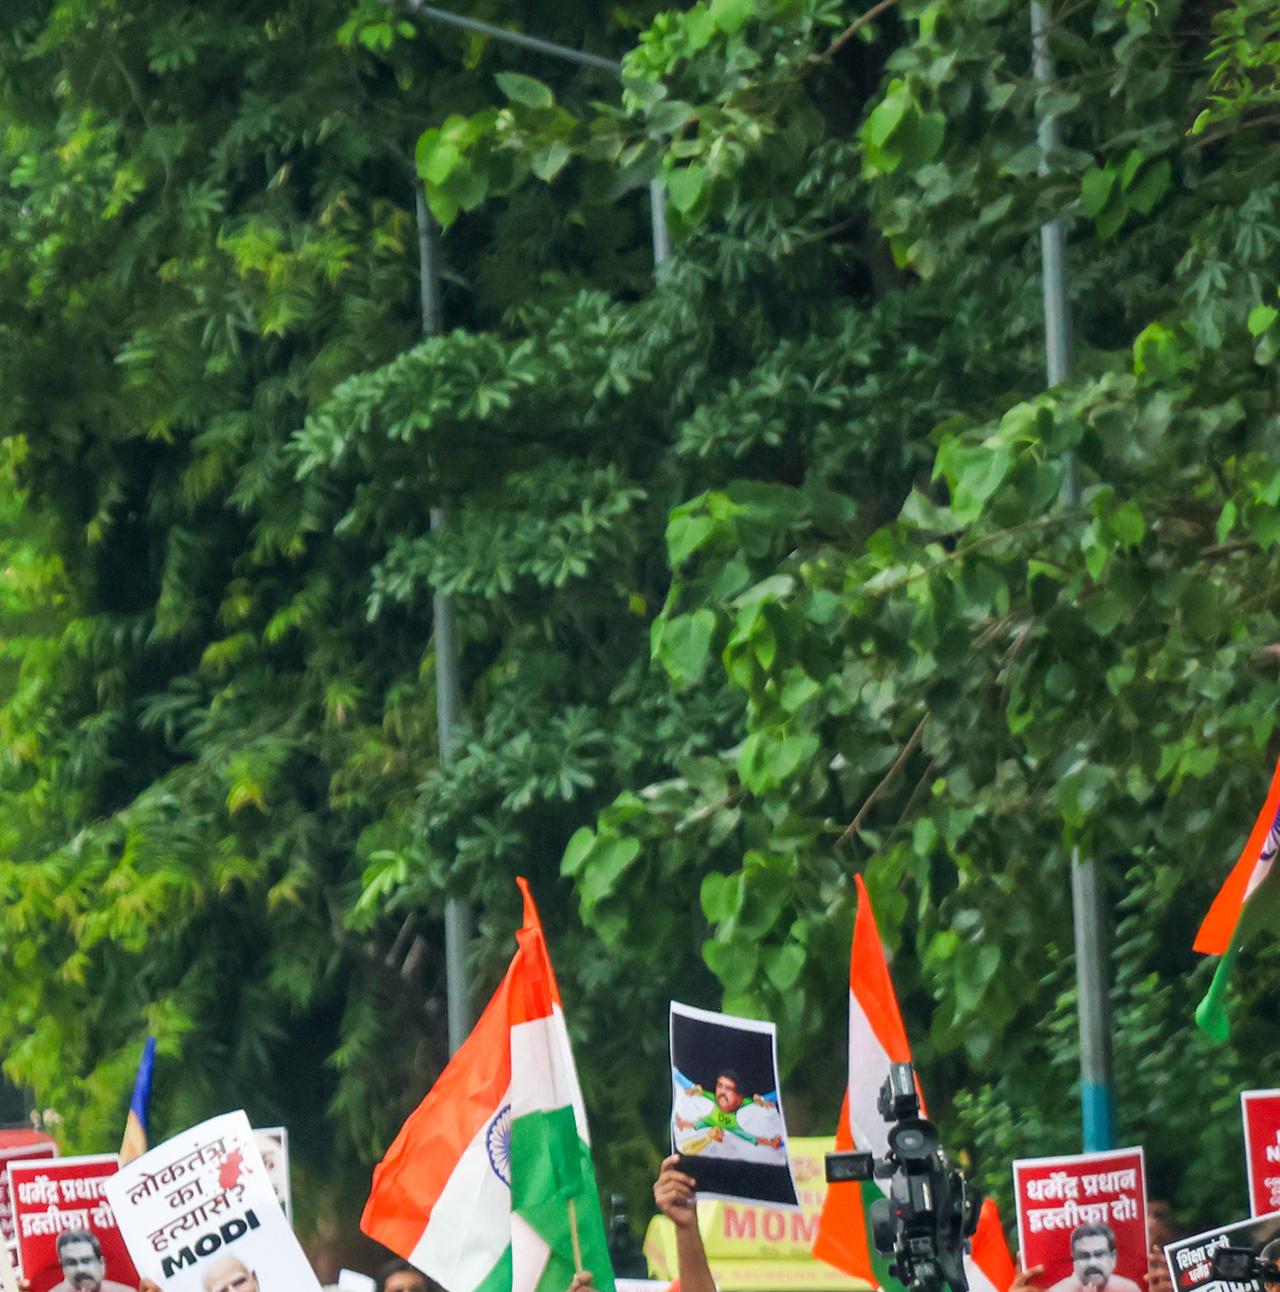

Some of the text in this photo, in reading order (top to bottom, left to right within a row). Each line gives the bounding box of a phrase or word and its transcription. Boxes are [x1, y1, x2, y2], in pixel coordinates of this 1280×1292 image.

[126, 1137, 228, 1206] लोकतंत्र
[1081, 1169, 1137, 1196] प्रधान
[164, 1177, 206, 1210] का
[20, 1204, 90, 1238] इस्तीफा
[1027, 1194, 1138, 1233] इस्तीफा दो!
[161, 1209, 261, 1279] MODI
